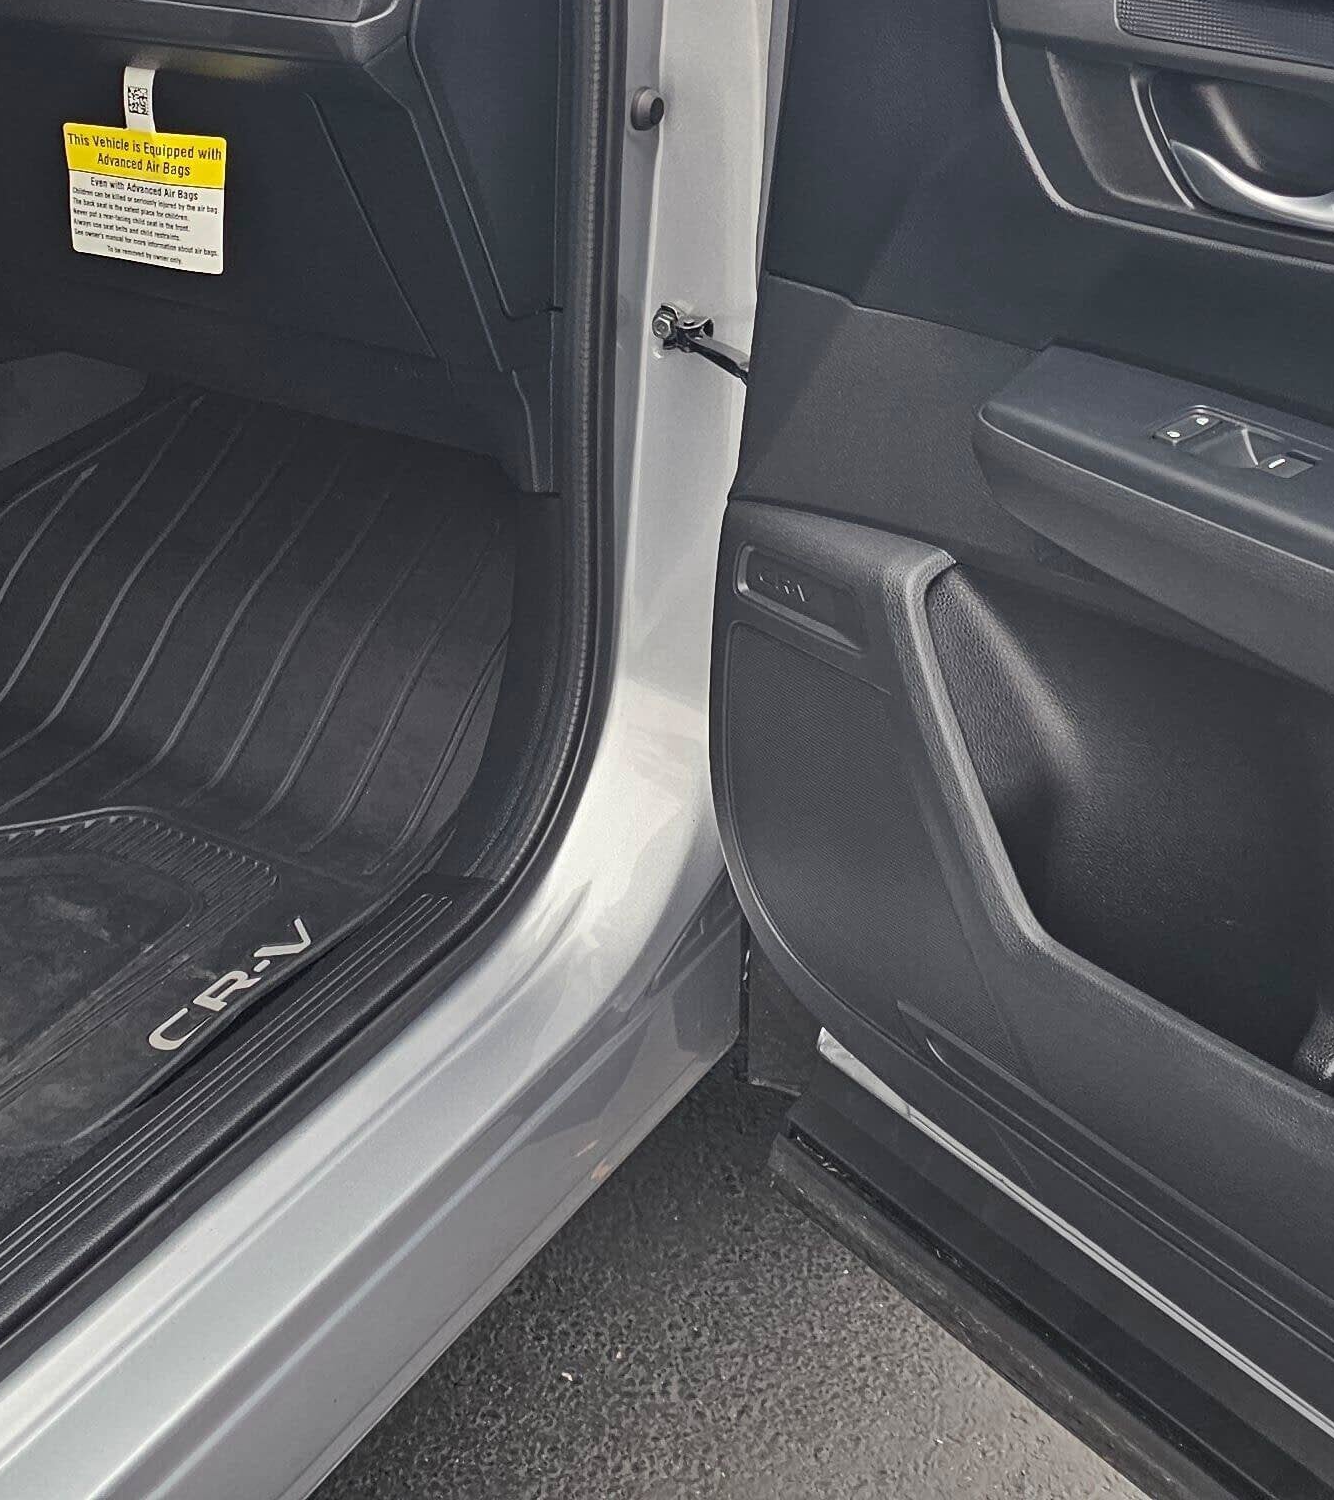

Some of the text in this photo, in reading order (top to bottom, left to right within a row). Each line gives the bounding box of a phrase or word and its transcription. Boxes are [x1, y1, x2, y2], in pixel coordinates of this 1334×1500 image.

[68, 133, 222, 160] This Vehicle is Equipped with
[97, 153, 191, 178] Advanced Air Bags
[91, 177, 198, 201] Even with Advanced Air Bags
[149, 918, 311, 1050] CR-V
